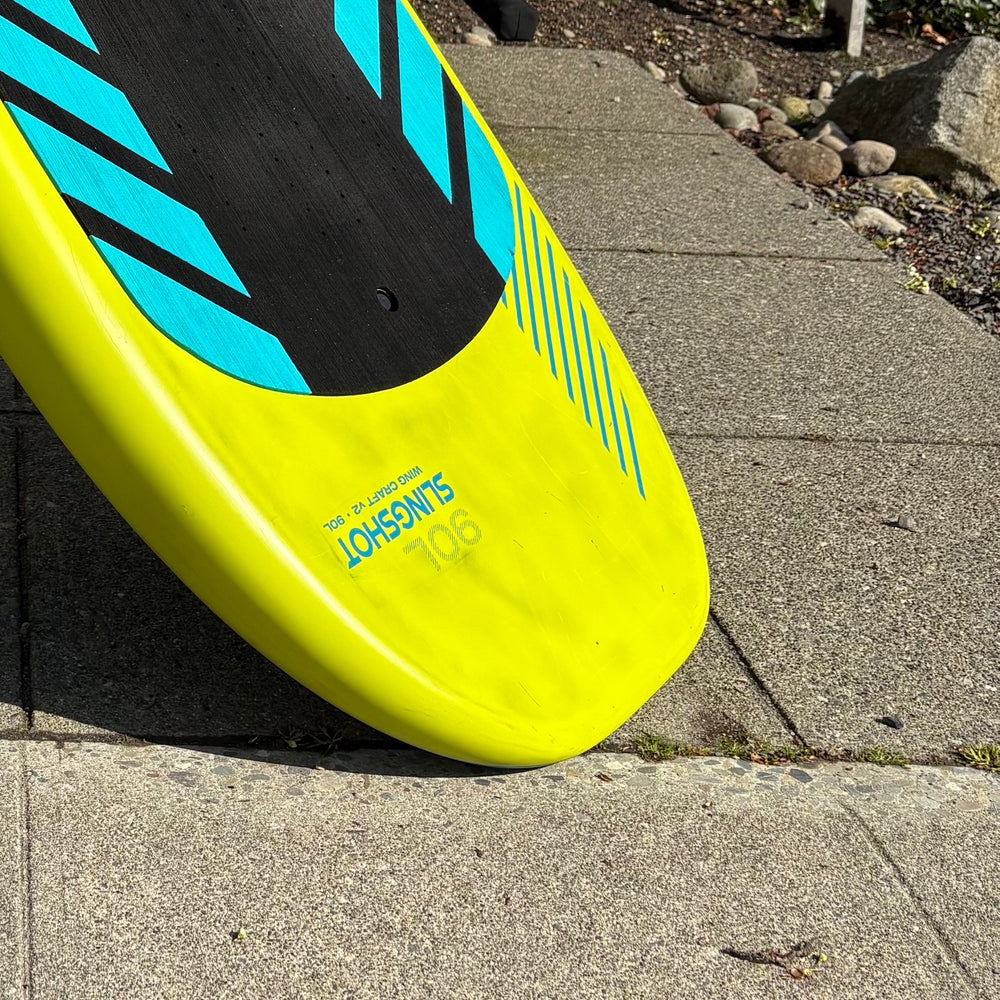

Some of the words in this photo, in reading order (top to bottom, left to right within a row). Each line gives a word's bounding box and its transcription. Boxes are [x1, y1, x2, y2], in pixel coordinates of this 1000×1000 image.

[397, 465, 423, 486] WING
[367, 481, 399, 507] CRAFT
[323, 515, 346, 532] 90L
[337, 471, 455, 570] SLINGSHOT
[403, 508, 482, 572] 90L
